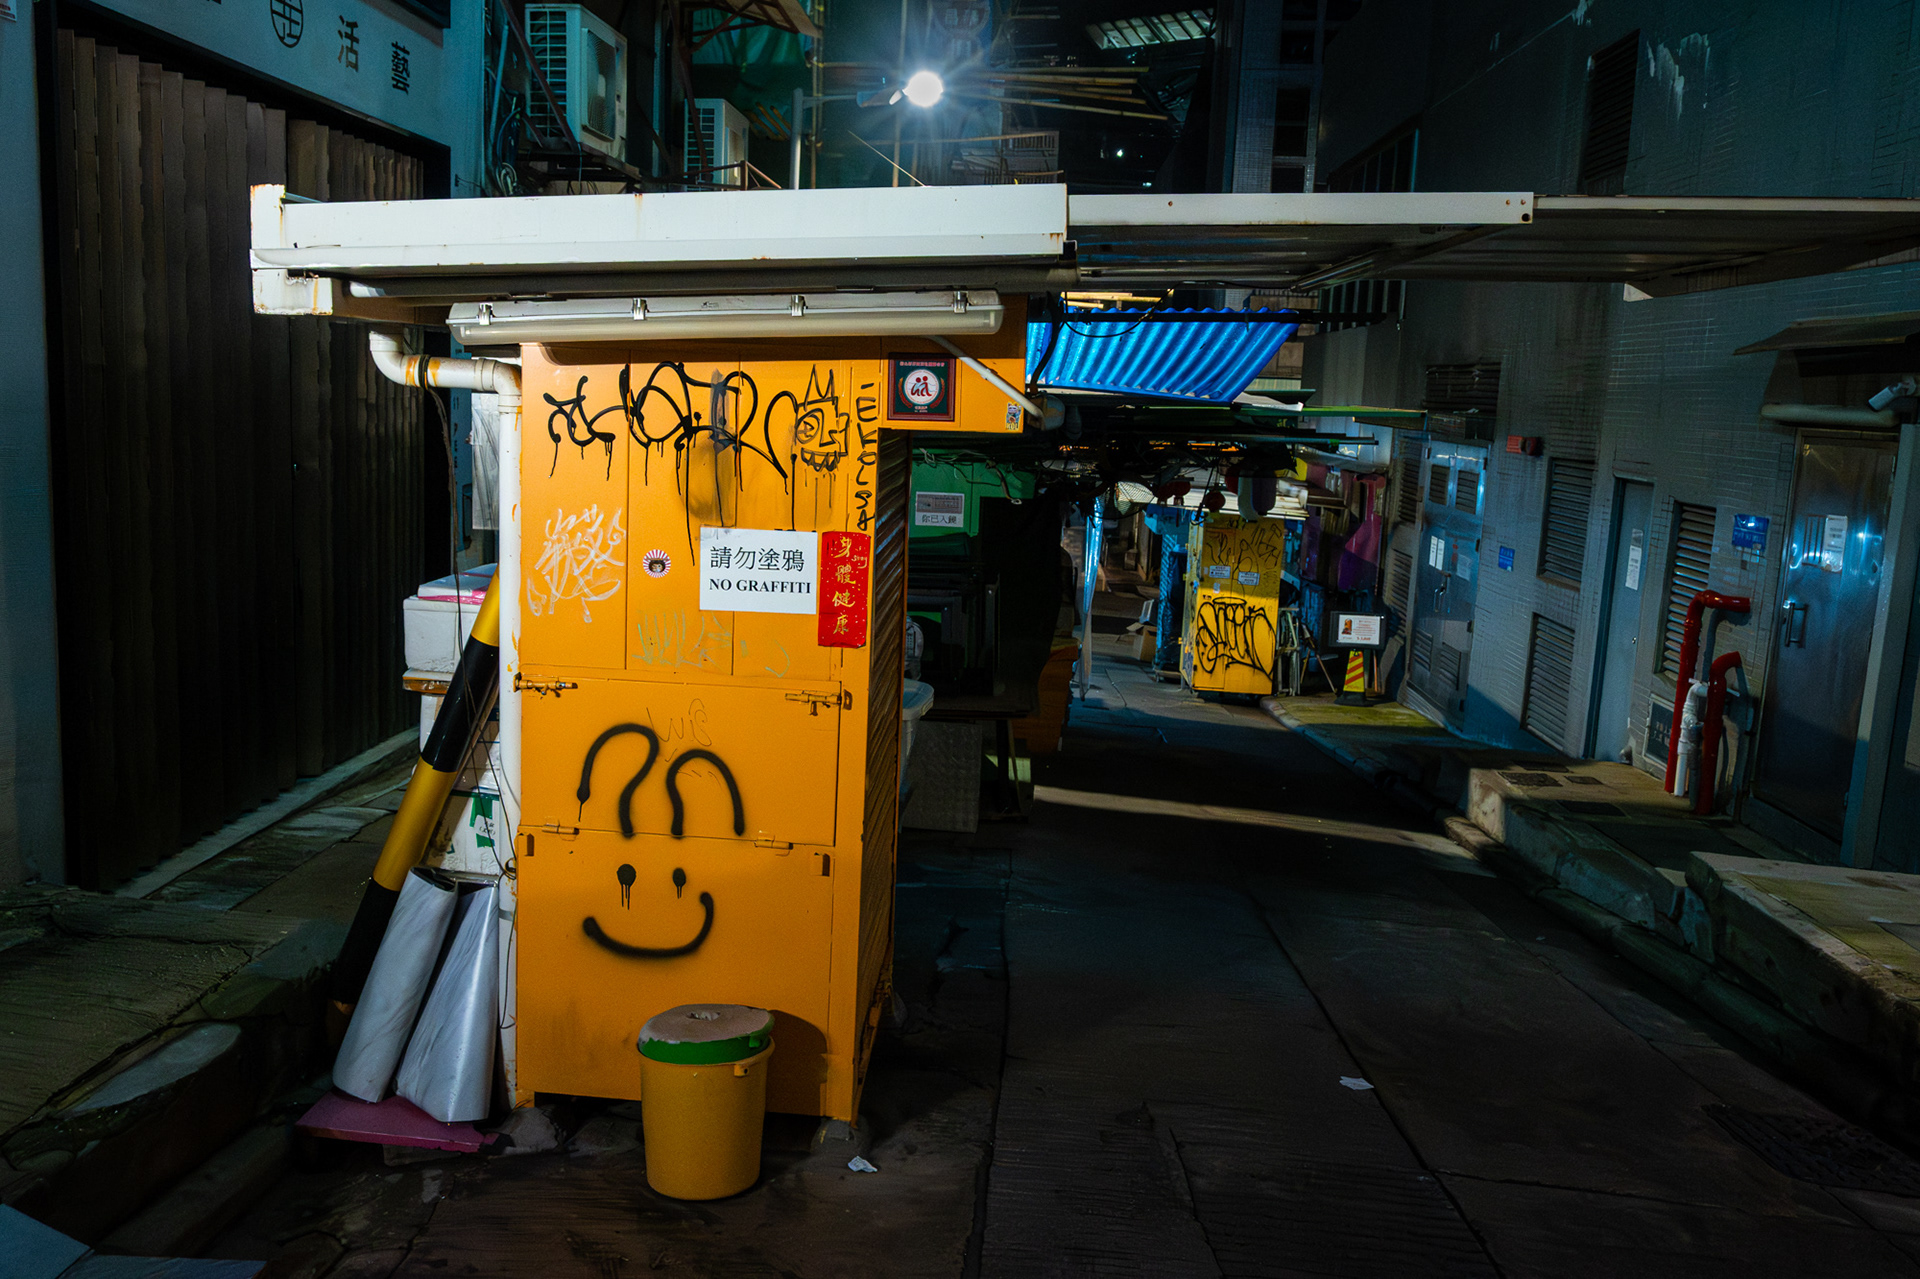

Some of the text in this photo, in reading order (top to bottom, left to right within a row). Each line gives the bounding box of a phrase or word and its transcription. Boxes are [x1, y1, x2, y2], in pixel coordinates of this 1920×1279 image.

[710, 546, 805, 572] 請勿塗鴉
[709, 578, 811, 594] NO GRAFFITI
